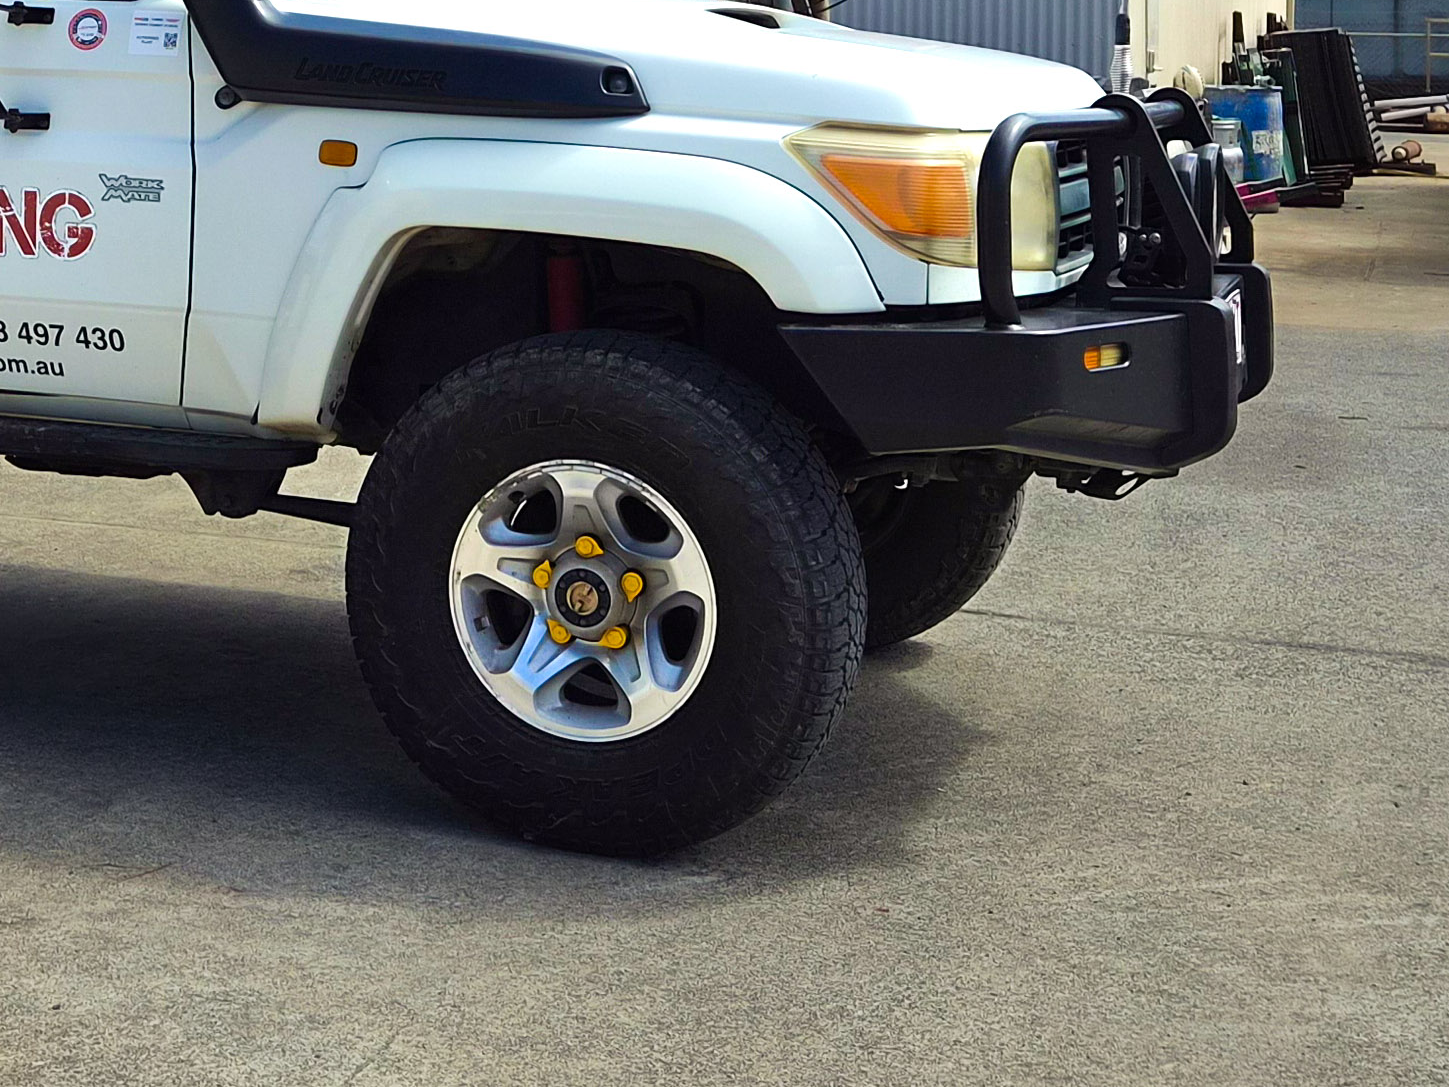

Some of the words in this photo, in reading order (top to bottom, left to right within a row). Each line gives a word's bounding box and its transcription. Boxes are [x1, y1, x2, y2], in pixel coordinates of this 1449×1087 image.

[98, 173, 164, 190] WORK
[101, 187, 161, 203] MATE
[18, 322, 65, 347] 497
[75, 326, 126, 353] 430
